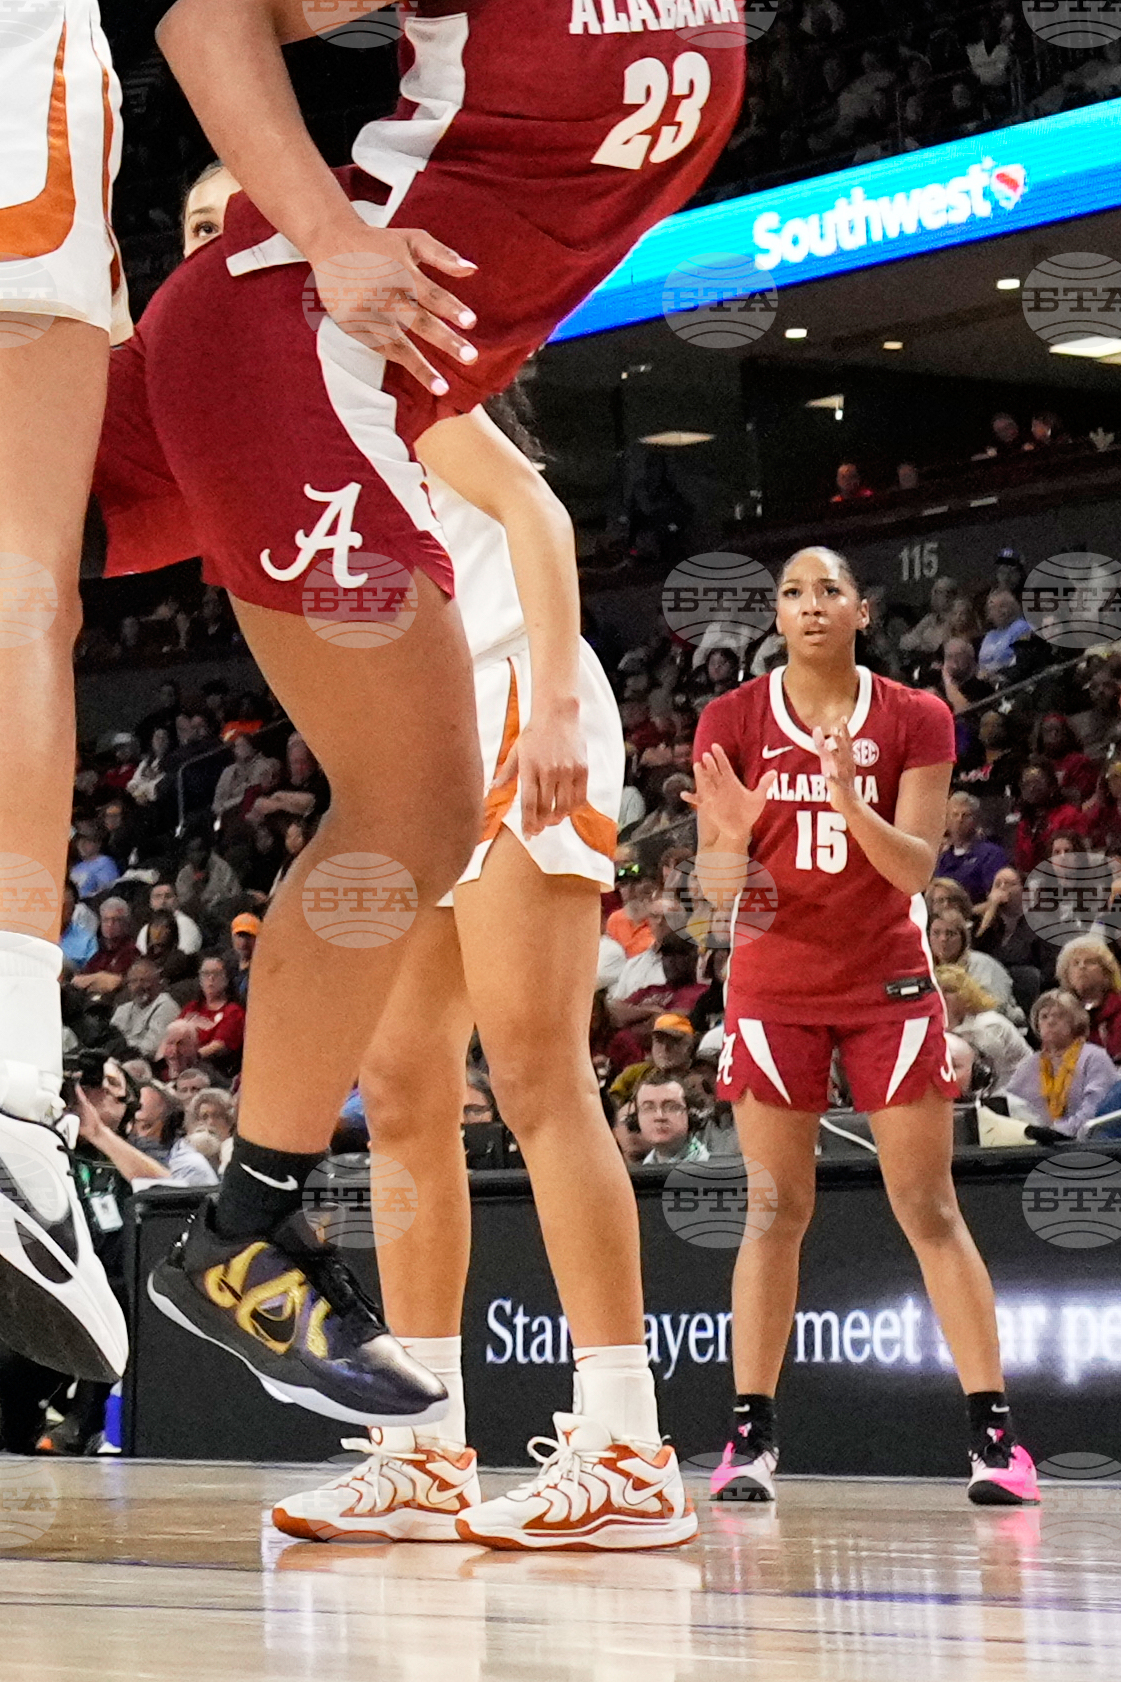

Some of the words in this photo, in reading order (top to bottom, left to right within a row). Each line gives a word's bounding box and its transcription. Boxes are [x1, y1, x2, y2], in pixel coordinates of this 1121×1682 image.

[590, 51, 711, 170] 23
[753, 161, 992, 271] Southwest
[260, 481, 369, 589] A
[899, 541, 939, 582] 115
[852, 741, 876, 765] SEC
[795, 810, 848, 875] 15
[794, 1297, 922, 1364] meet
